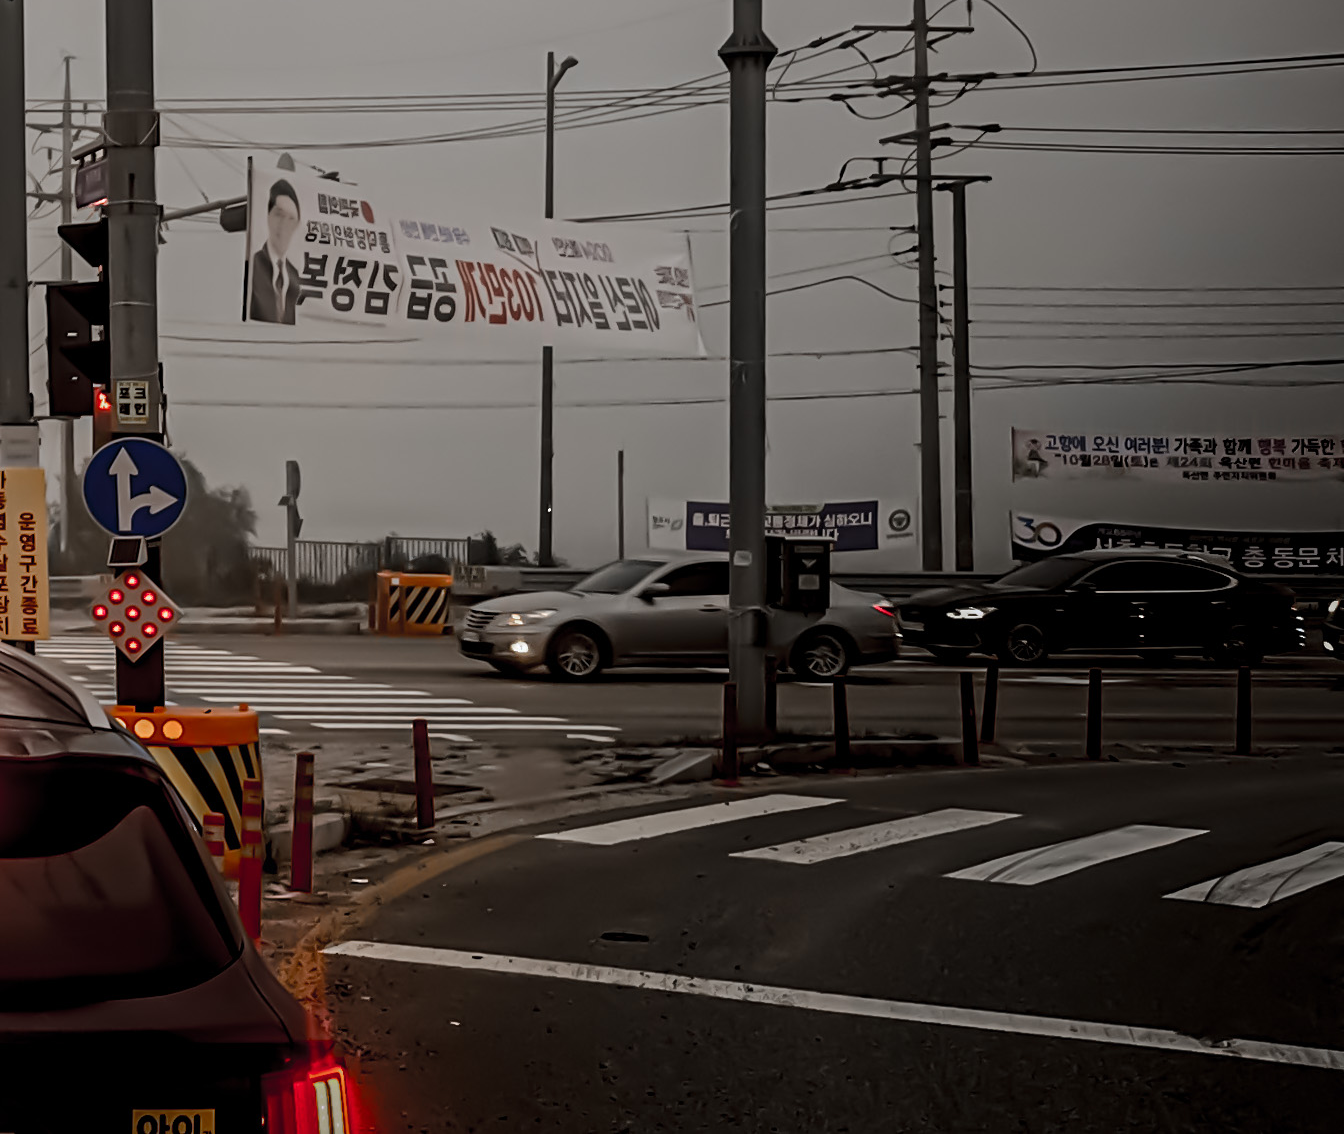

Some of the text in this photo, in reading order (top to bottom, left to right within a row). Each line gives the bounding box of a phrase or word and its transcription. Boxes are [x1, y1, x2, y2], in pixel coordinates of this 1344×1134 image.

[1045, 435, 1087, 453] 고향에
[1091, 436, 1119, 453] 오신
[1124, 437, 1170, 454] 여러분!
[1174, 438, 1217, 455] 가족과
[1223, 438, 1252, 455] 함께
[1257, 439, 1287, 456] 행복
[1292, 439, 1336, 456] 가득한
